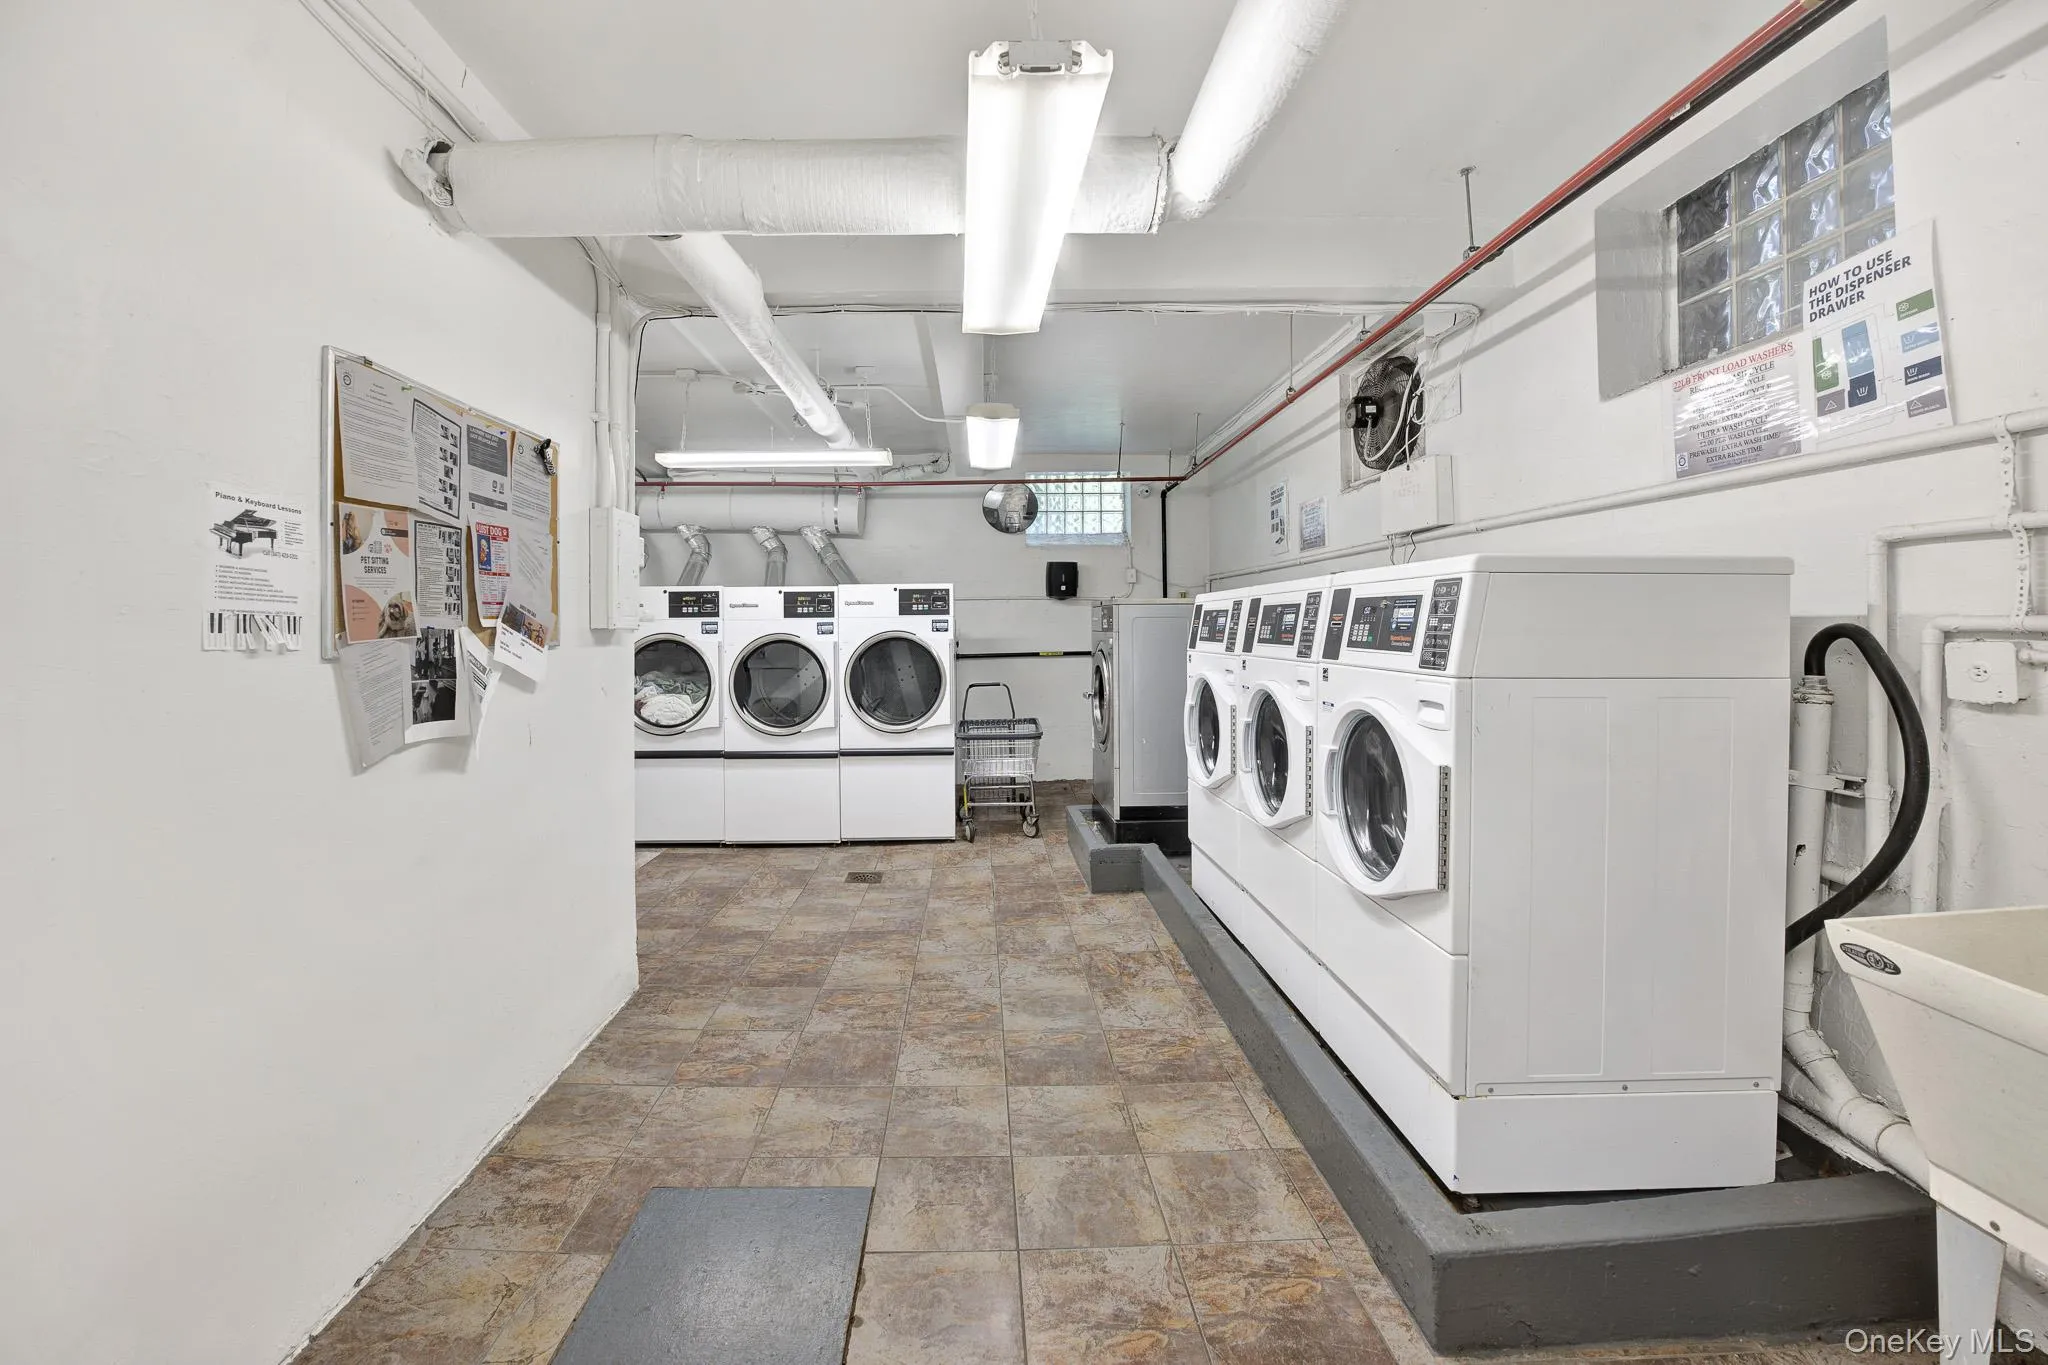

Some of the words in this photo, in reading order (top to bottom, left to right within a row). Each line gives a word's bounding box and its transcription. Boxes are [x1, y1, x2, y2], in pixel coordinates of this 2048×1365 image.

[1809, 274, 1841, 298] HOW
[1843, 265, 1862, 281] TO
[1866, 250, 1893, 271] USE
[1809, 292, 1832, 310] THE
[1835, 255, 1912, 299] DISPENSER
[1809, 290, 1866, 323] DRAWER
[1692, 366, 1721, 382] FRONT
[1722, 358, 1747, 373] LOAD
[1749, 341, 1794, 364] WASHERS
[1727, 431, 1746, 440] WASH
[1689, 447, 1718, 459] PREWASH
[1721, 442, 1743, 452] EXTRA
[1743, 436, 1762, 447] WASH
[1706, 454, 1727, 464] EXTRA
[1727, 448, 1746, 459] RINSE
[215, 491, 236, 501] Piano
[245, 497, 276, 510] Keyboard
[277, 504, 302, 515] Lessons
[360, 555, 371, 565] PET
[371, 556, 390, 566] SITTING
[364, 565, 387, 575] SERVICES
